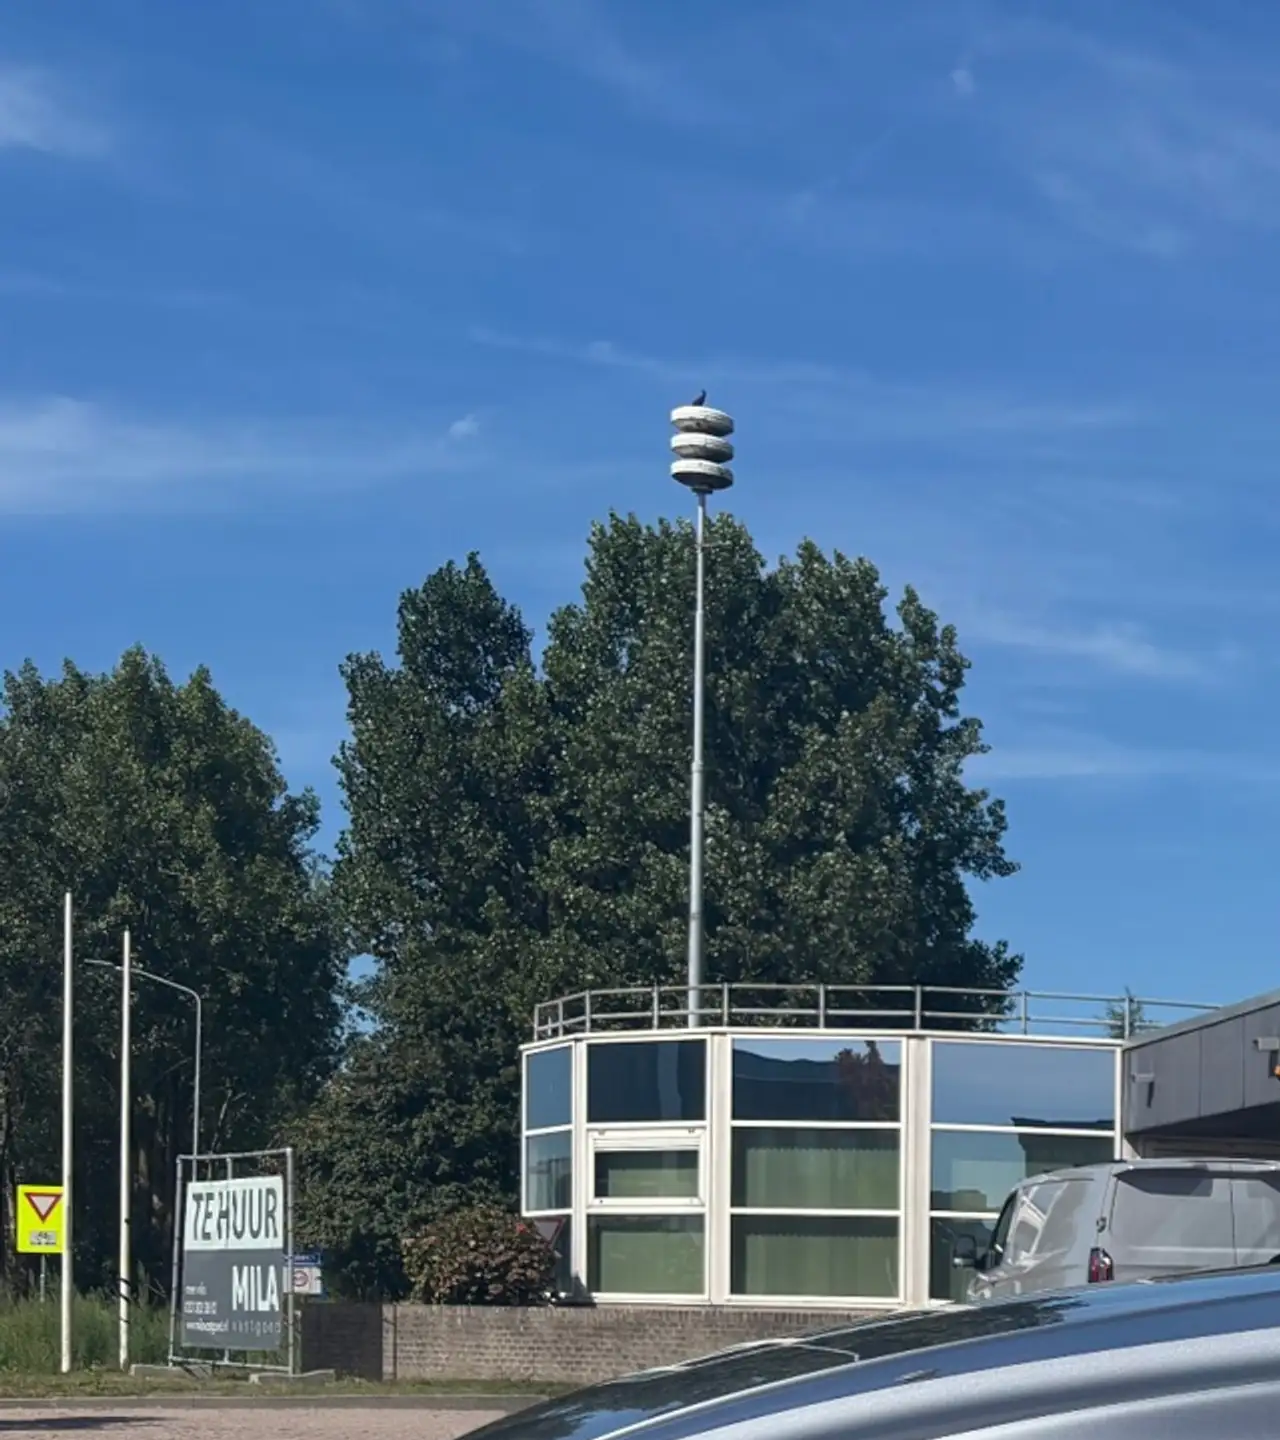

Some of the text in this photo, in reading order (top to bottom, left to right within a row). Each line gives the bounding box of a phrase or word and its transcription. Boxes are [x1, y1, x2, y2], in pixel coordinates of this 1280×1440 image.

[192, 1187, 279, 1242] TE HUUR
[231, 1265, 280, 1312] MILA
